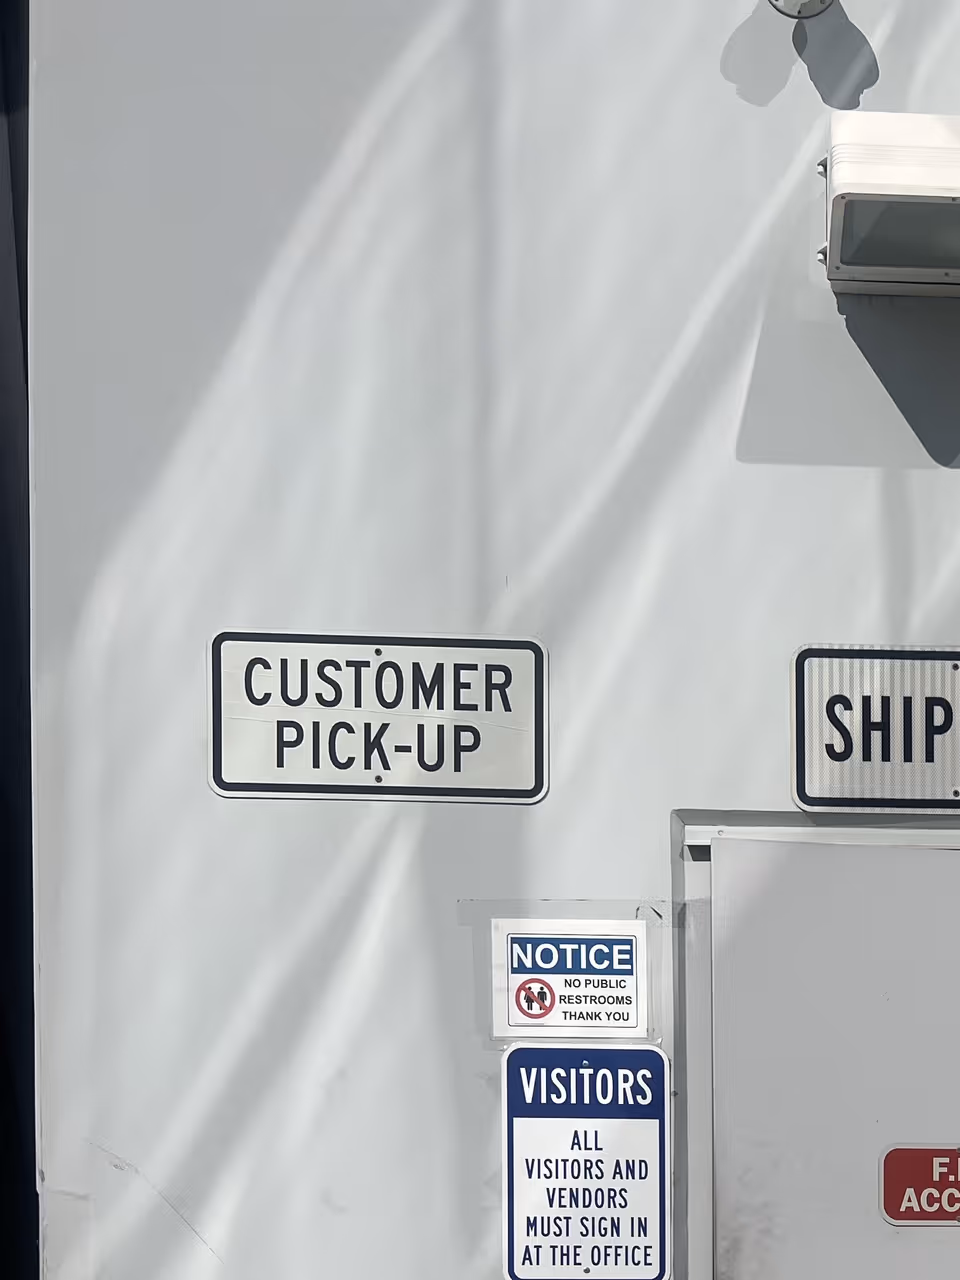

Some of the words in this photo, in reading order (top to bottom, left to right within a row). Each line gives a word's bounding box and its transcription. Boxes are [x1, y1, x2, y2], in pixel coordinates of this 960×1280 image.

[244, 656, 513, 713] CUSTOMER
[276, 719, 482, 773] PICK-UP
[512, 943, 632, 970] NOTICE
[564, 979, 581, 988] NO
[584, 979, 627, 989] PUBLIC
[559, 995, 632, 1005] RESTROOMS
[562, 1011, 602, 1021] THANK
[605, 1012, 630, 1021] YOU
[519, 1066, 653, 1106] VISITORS
[570, 1130, 603, 1151] ALL
[525, 1158, 605, 1181] VISITORS
[612, 1158, 649, 1181] AND
[546, 1187, 629, 1209] VENDORS
[526, 1216, 572, 1238] MUST
[579, 1216, 620, 1238] SIGN
[630, 1216, 648, 1238] IN
[522, 1245, 543, 1267] AT
[549, 1244, 582, 1267] THE
[590, 1245, 653, 1267] OFFICE
